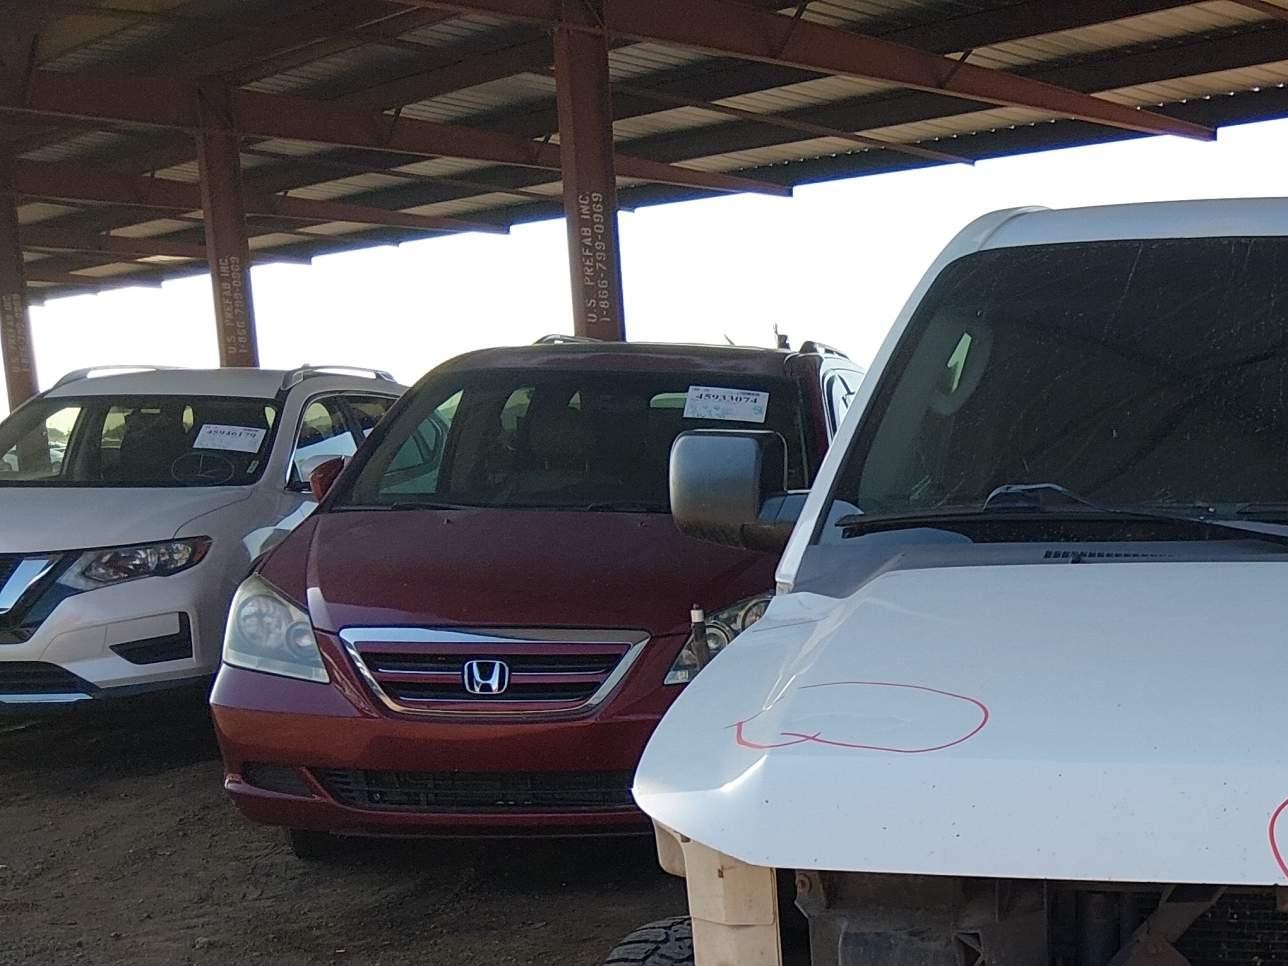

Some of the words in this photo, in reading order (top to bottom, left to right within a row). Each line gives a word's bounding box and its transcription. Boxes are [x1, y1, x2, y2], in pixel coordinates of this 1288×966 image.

[578, 191, 591, 219] INC.
[581, 227, 594, 286] PREFAB
[591, 192, 611, 321] 1-866-799-0969
